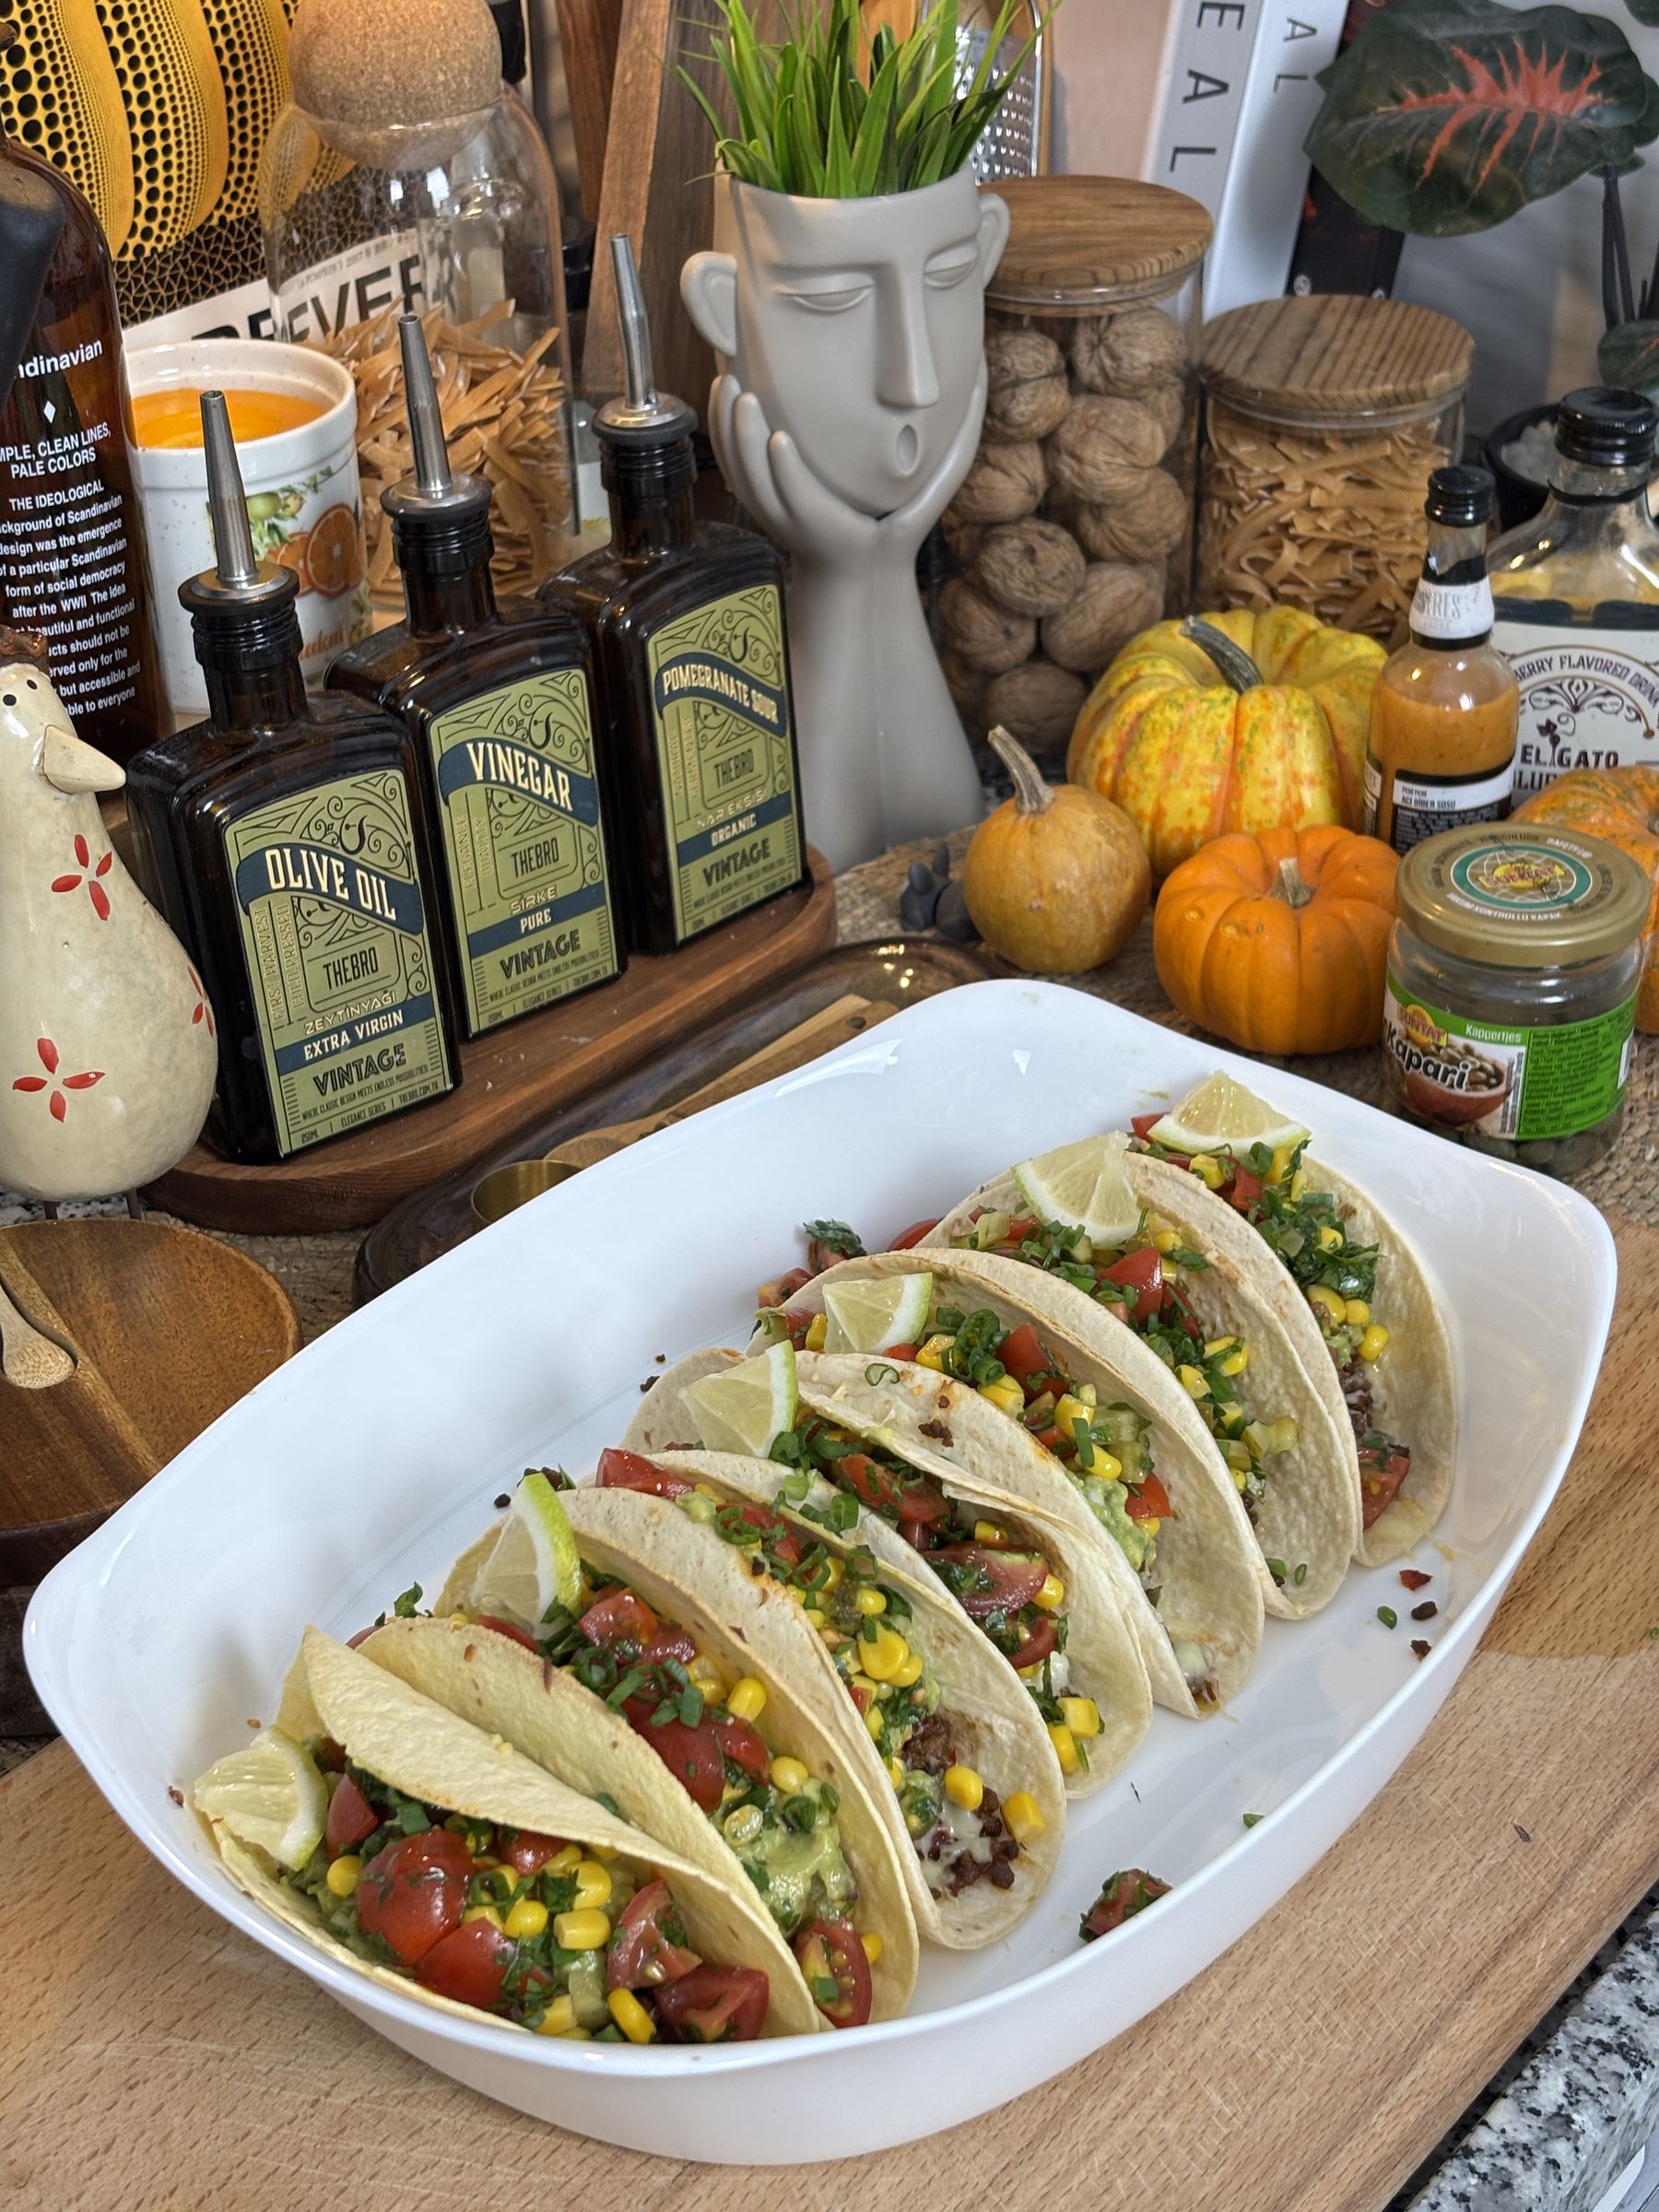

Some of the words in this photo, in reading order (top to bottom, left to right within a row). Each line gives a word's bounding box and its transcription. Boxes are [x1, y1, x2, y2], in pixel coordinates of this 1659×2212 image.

[38, 433, 79, 455] CLEAN
[81, 421, 111, 446] LINES,
[11, 463, 45, 478] PALE
[48, 447, 96, 474] COLORS
[9, 497, 33, 512] THE
[35, 478, 104, 510] IDEOLOGICAL
[55, 512, 66, 527] of
[67, 493, 123, 524] Scandinavian
[36, 539, 57, 552] was
[59, 535, 76, 548] the
[77, 518, 123, 544] emergence
[9, 565, 17, 576] a
[18, 557, 69, 578] particular
[71, 537, 127, 566] Scandinavian
[6, 583, 31, 598] form
[33, 582, 45, 595] of
[47, 576, 77, 594] social
[79, 560, 125, 587] democracy
[12, 604, 37, 618] after
[40, 602, 57, 615] the
[61, 594, 88, 612] WWII
[90, 591, 109, 605] The
[76, 616, 95, 630] and
[96, 599, 135, 627] functional
[70, 633, 103, 653] should
[104, 629, 120, 645] not
[120, 624, 130, 639] be
[59, 683, 77, 698] but
[78, 668, 126, 692] accessible
[127, 660, 140, 677] and
[78, 655, 99, 676] only
[100, 652, 112, 667] for
[114, 646, 128, 662] the
[1559, 654, 1630, 680] FLAVORED
[86, 700, 96, 713] to
[97, 686, 135, 712] everyone
[663, 664, 750, 708] POMEGRANATE
[466, 741, 573, 812] VINEGAR
[1557, 747, 1619, 770] GATO
[711, 813, 757, 847] ORGANIC
[511, 837, 559, 878] THEBRO
[702, 837, 771, 888] VINTAGE
[265, 847, 349, 900] OLIVE
[356, 868, 396, 921] OIL
[276, 904, 298, 970] PRESSED
[520, 908, 552, 935] PURE
[254, 906, 277, 977] HARVEST
[500, 928, 582, 980] VINTAGE
[324, 947, 379, 990] THEBRO
[266, 980, 286, 1022] FIRST
[303, 1032, 351, 1061] EXTRA
[355, 1009, 404, 1040] VIRGIN
[312, 1043, 406, 1096] VINTAGE
[1386, 1020, 1472, 1091] Kapari
[341, 1110, 367, 1127] ELEGANCE
